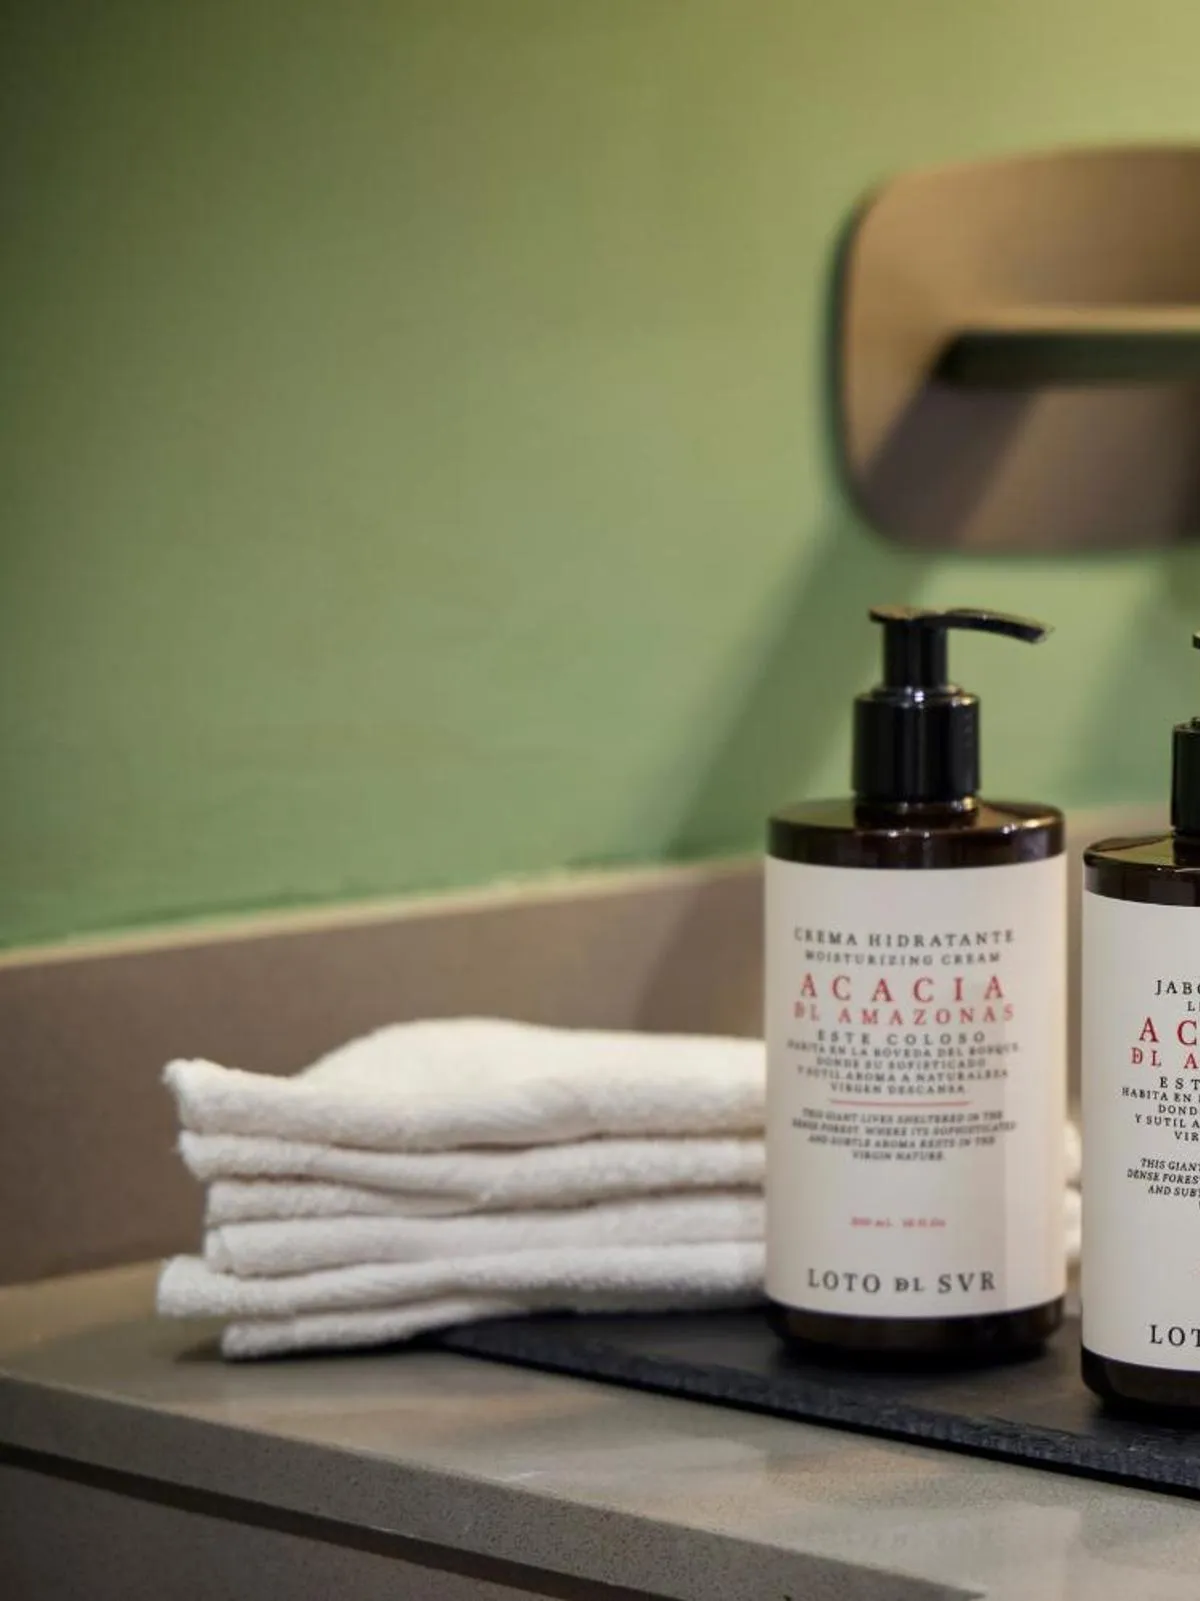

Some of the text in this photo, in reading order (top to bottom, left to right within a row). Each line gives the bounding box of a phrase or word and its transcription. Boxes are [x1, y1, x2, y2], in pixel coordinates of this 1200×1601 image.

[794, 928, 1014, 948] CREMA HIDRATANTE
[805, 950, 1000, 966] MOISTURIZING CREAM
[800, 972, 1003, 1002] ACACIA
[838, 1003, 1014, 1026] AMAZONAS
[818, 1029, 985, 1046] ESTE COLOSO
[1121, 1087, 1169, 1102] HABITA
[1173, 1092, 1192, 1103] EN
[1134, 1112, 1142, 1124] Y
[1146, 1115, 1186, 1129] SUTIL
[1140, 1157, 1166, 1170] THIS
[1127, 1168, 1160, 1182] DENSE
[1147, 1184, 1171, 1196] AND
[807, 1268, 881, 1293] LOTO
[938, 1270, 996, 1294] SVR
